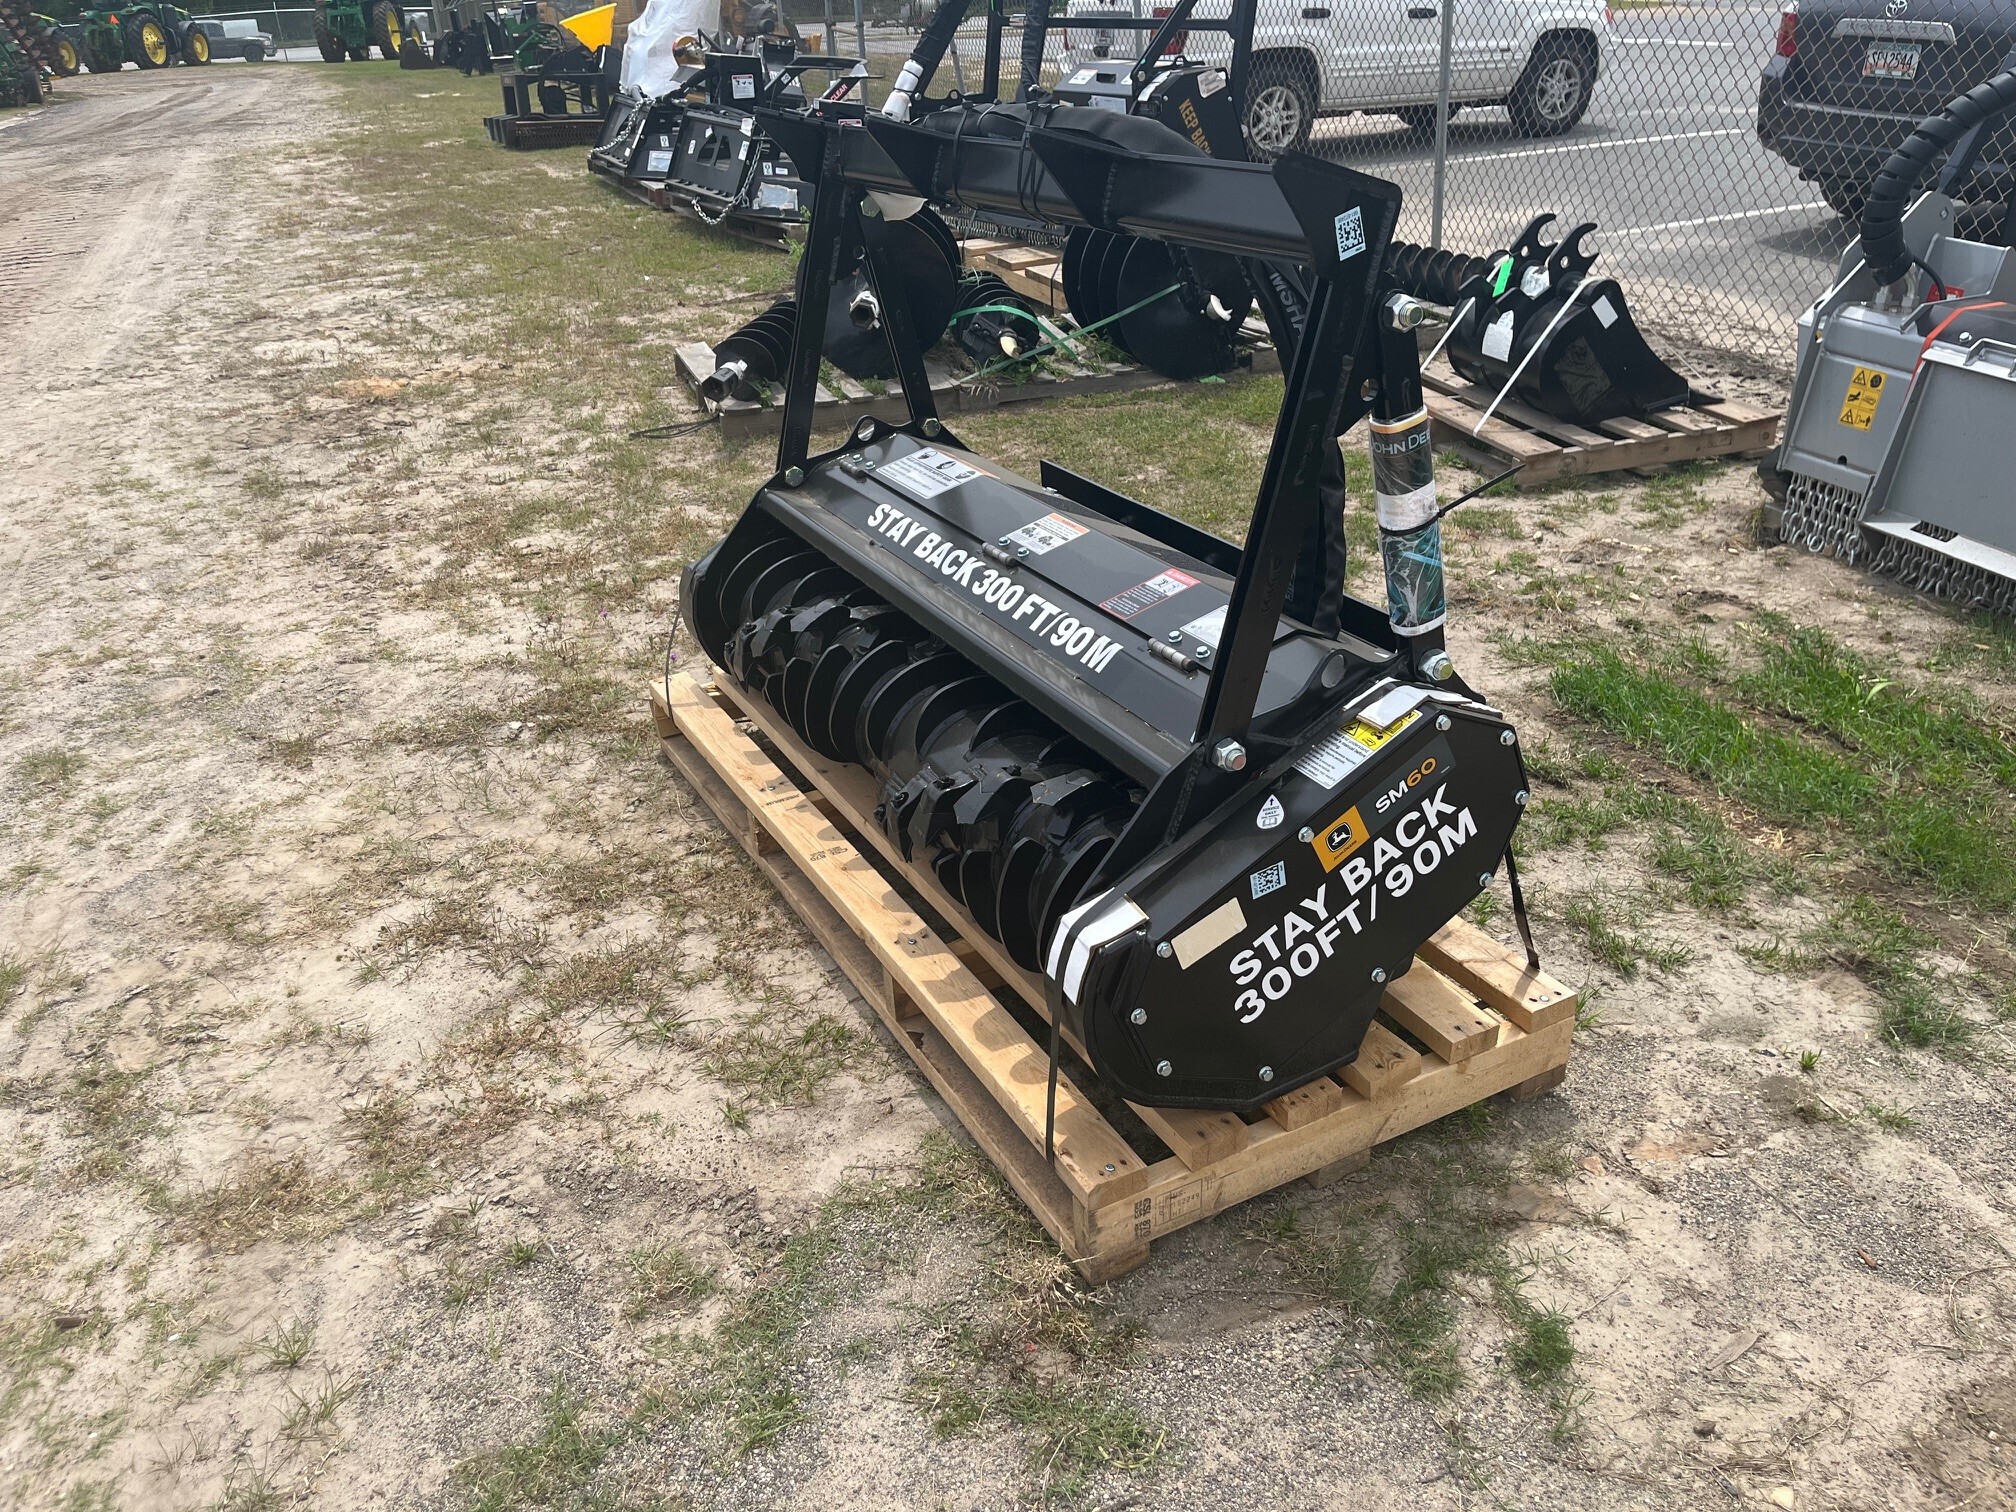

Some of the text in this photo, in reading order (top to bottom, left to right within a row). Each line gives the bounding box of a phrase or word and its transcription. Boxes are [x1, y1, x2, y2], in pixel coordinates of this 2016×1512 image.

[830, 84, 848, 101] CLEAR
[1179, 99, 1199, 129] KEEP
[867, 503, 928, 548] STAY
[914, 531, 986, 588] BACK
[972, 568, 1027, 612] 300
[1375, 757, 1438, 814] SM60
[1229, 782, 1457, 986] STAY BACK
